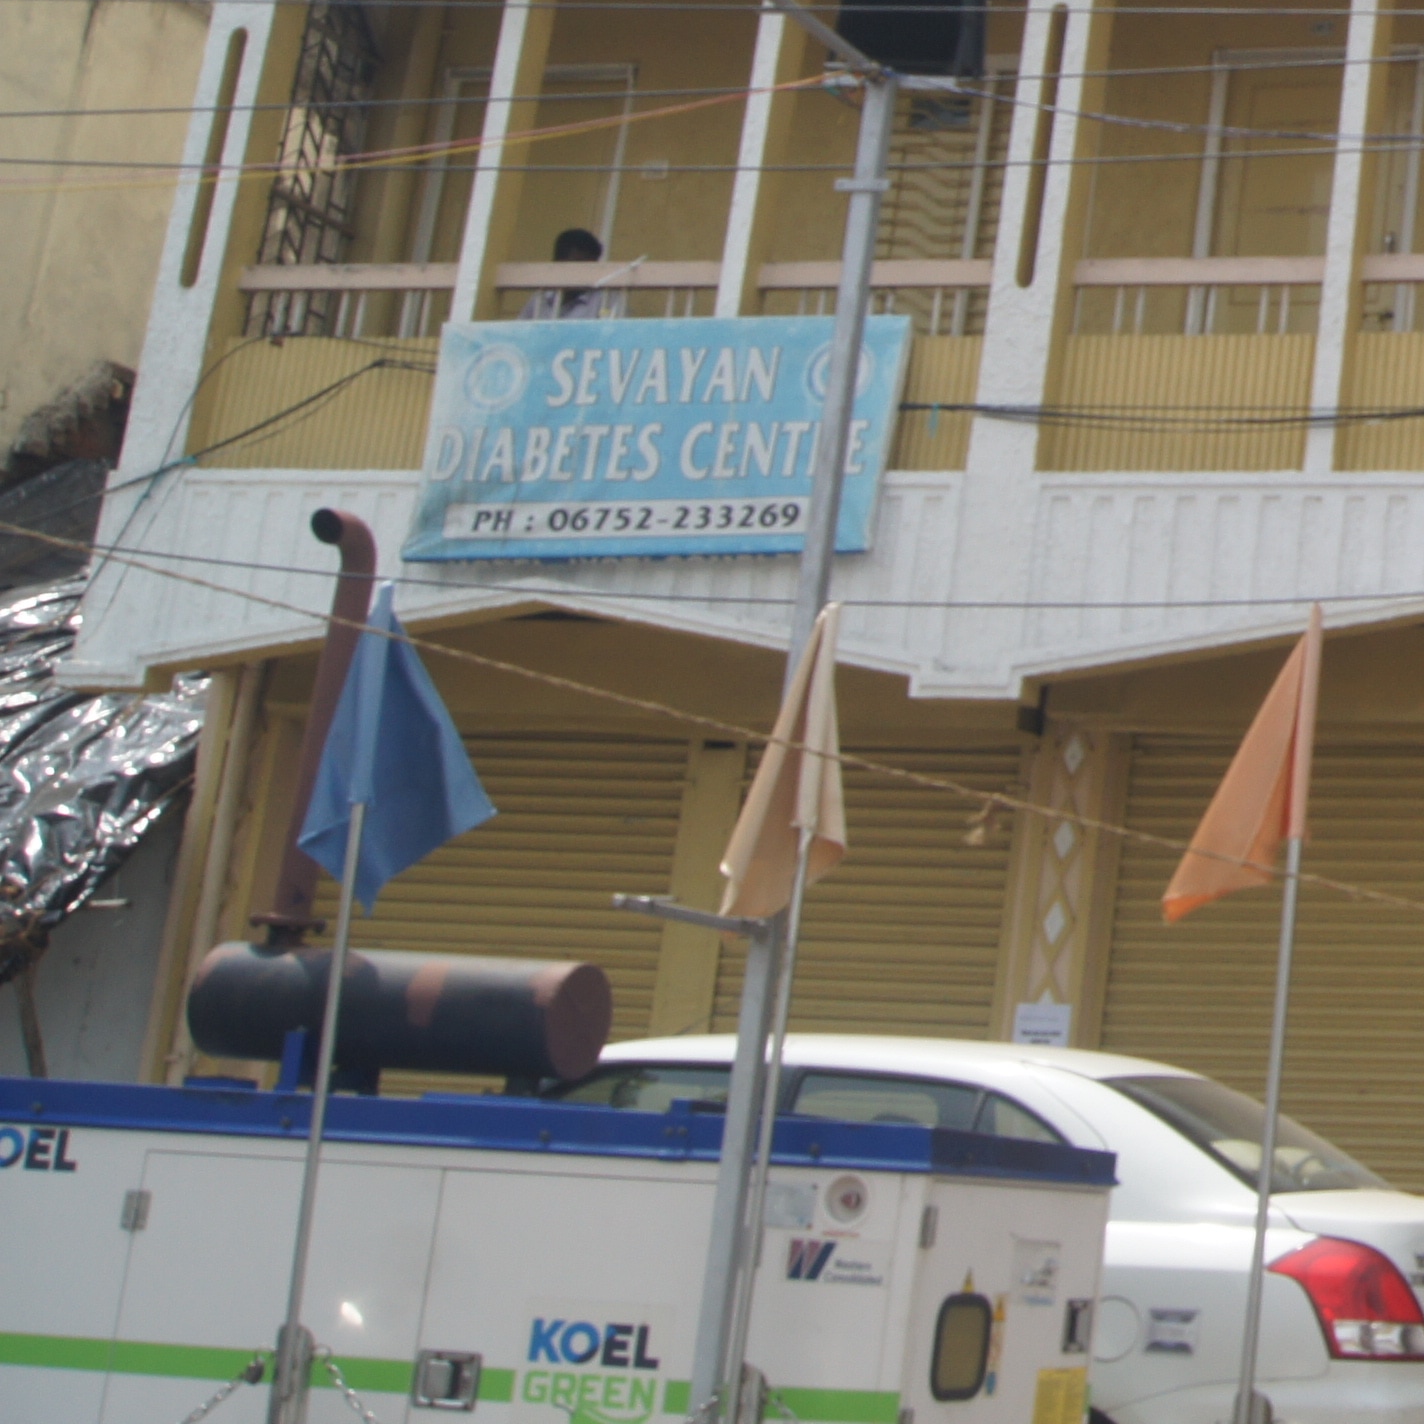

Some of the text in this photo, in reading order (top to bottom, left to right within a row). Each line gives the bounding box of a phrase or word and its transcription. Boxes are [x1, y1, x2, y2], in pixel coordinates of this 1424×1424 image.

[546, 346, 781, 408] SEVAYAN
[430, 419, 869, 482] DIABETES CENTE
[470, 509, 513, 533] PH
[547, 502, 801, 532] 06752-233269
[0, 1126, 77, 1171] OEL
[527, 1317, 660, 1370] KOEL
[522, 1369, 657, 1411] GREEN
